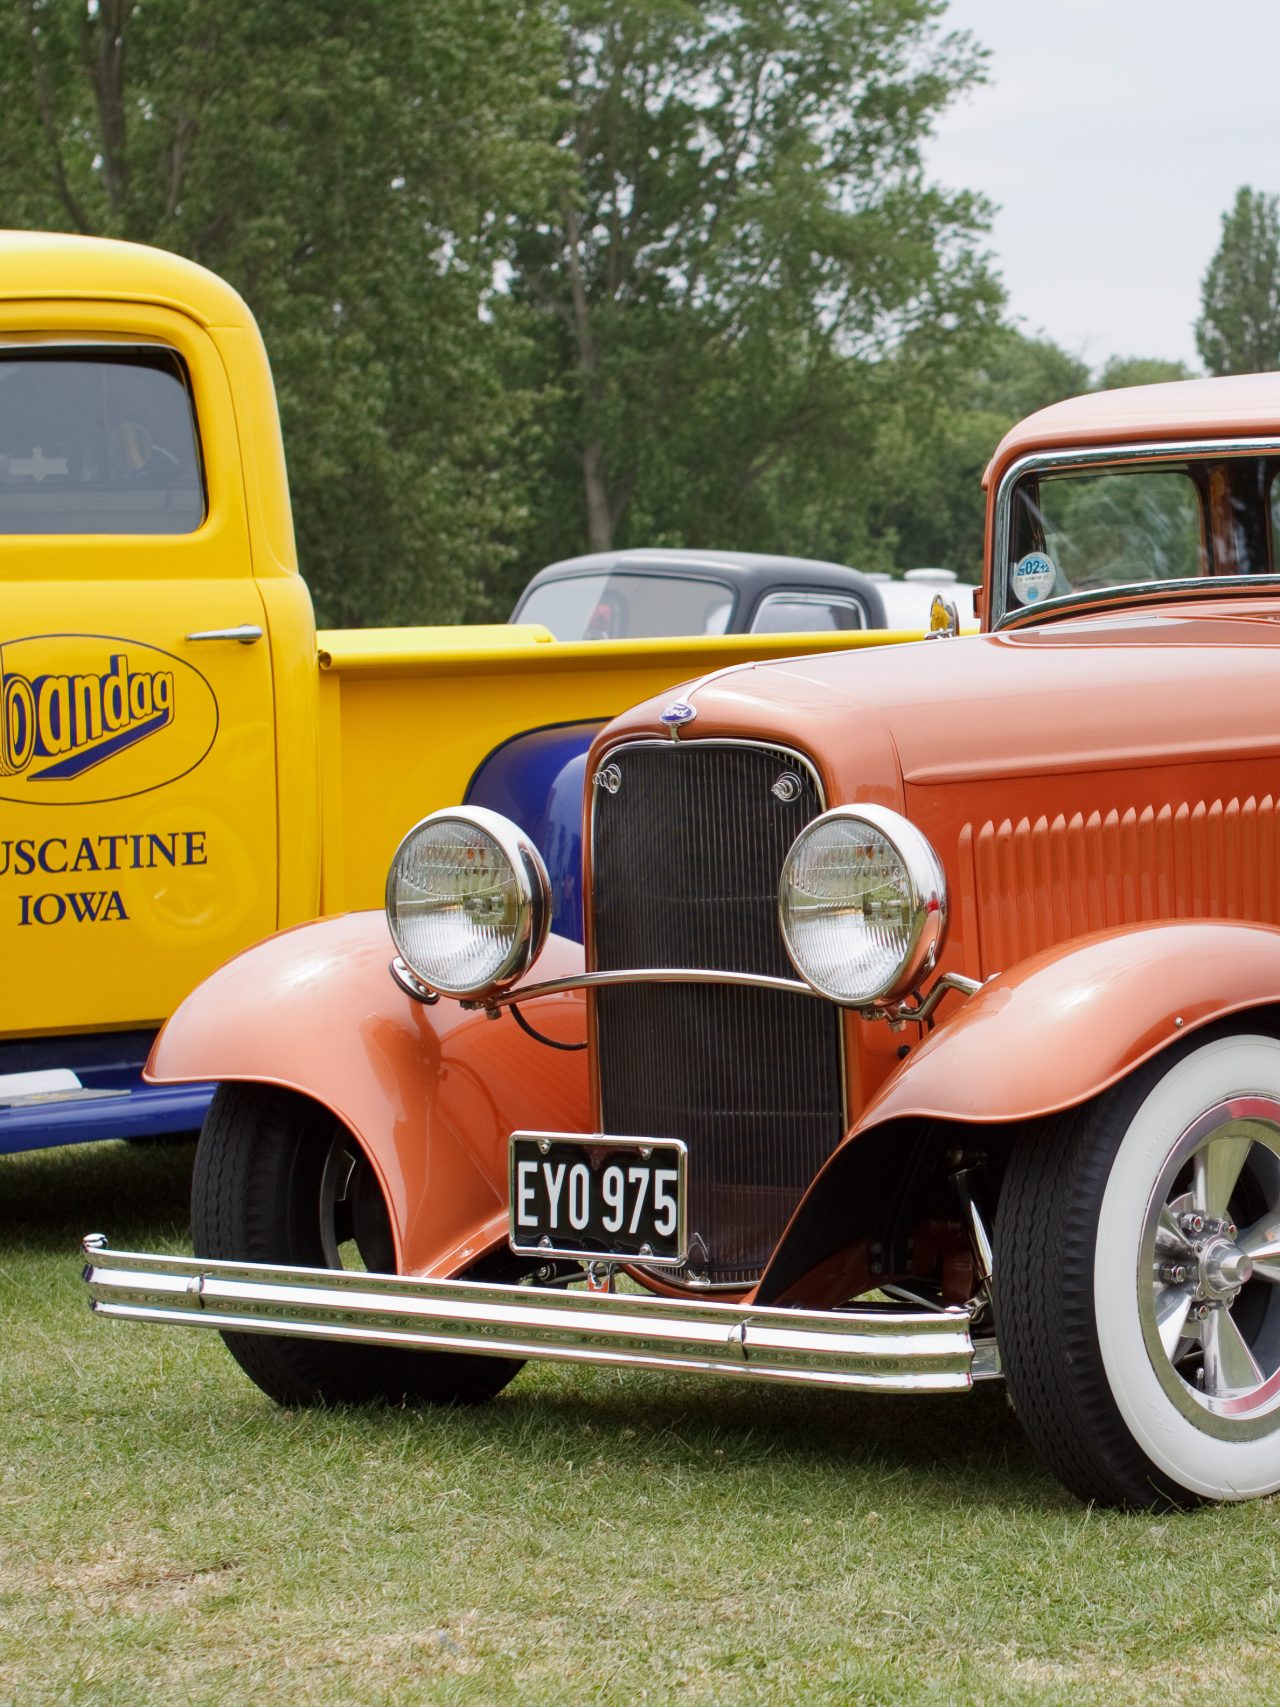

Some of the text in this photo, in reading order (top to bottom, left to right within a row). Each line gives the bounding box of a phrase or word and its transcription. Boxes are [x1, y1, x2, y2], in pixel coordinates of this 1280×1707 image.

[1026, 560, 1040, 575] 02
[662, 703, 690, 718] Ford
[18, 890, 130, 926] IOWA
[517, 1160, 678, 1236] EYO 975
